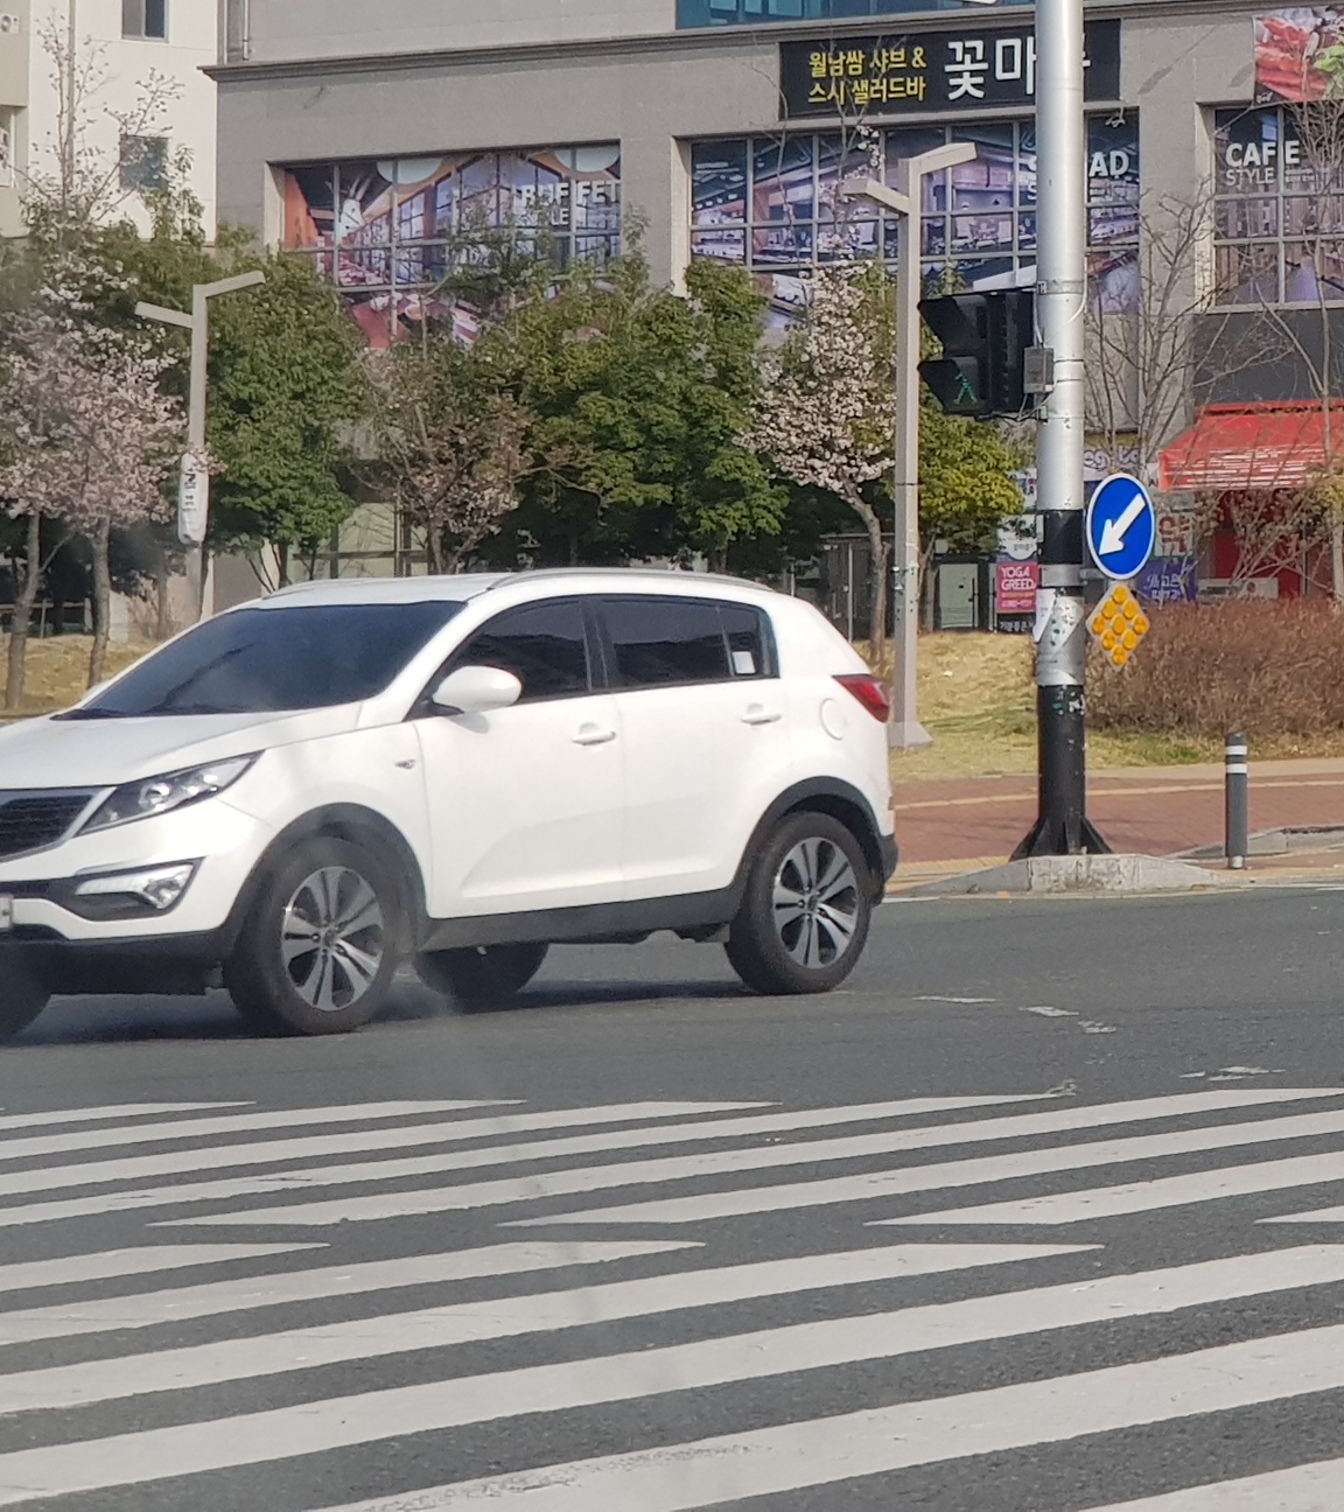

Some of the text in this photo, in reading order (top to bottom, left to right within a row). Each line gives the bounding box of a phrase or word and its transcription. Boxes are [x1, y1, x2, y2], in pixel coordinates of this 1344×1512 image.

[808, 46, 927, 78] 월남쌈 샤브 &
[808, 77, 926, 106] 스시 샐러드바
[1225, 139, 1301, 168] CAFE
[1225, 168, 1276, 187] STYLE
